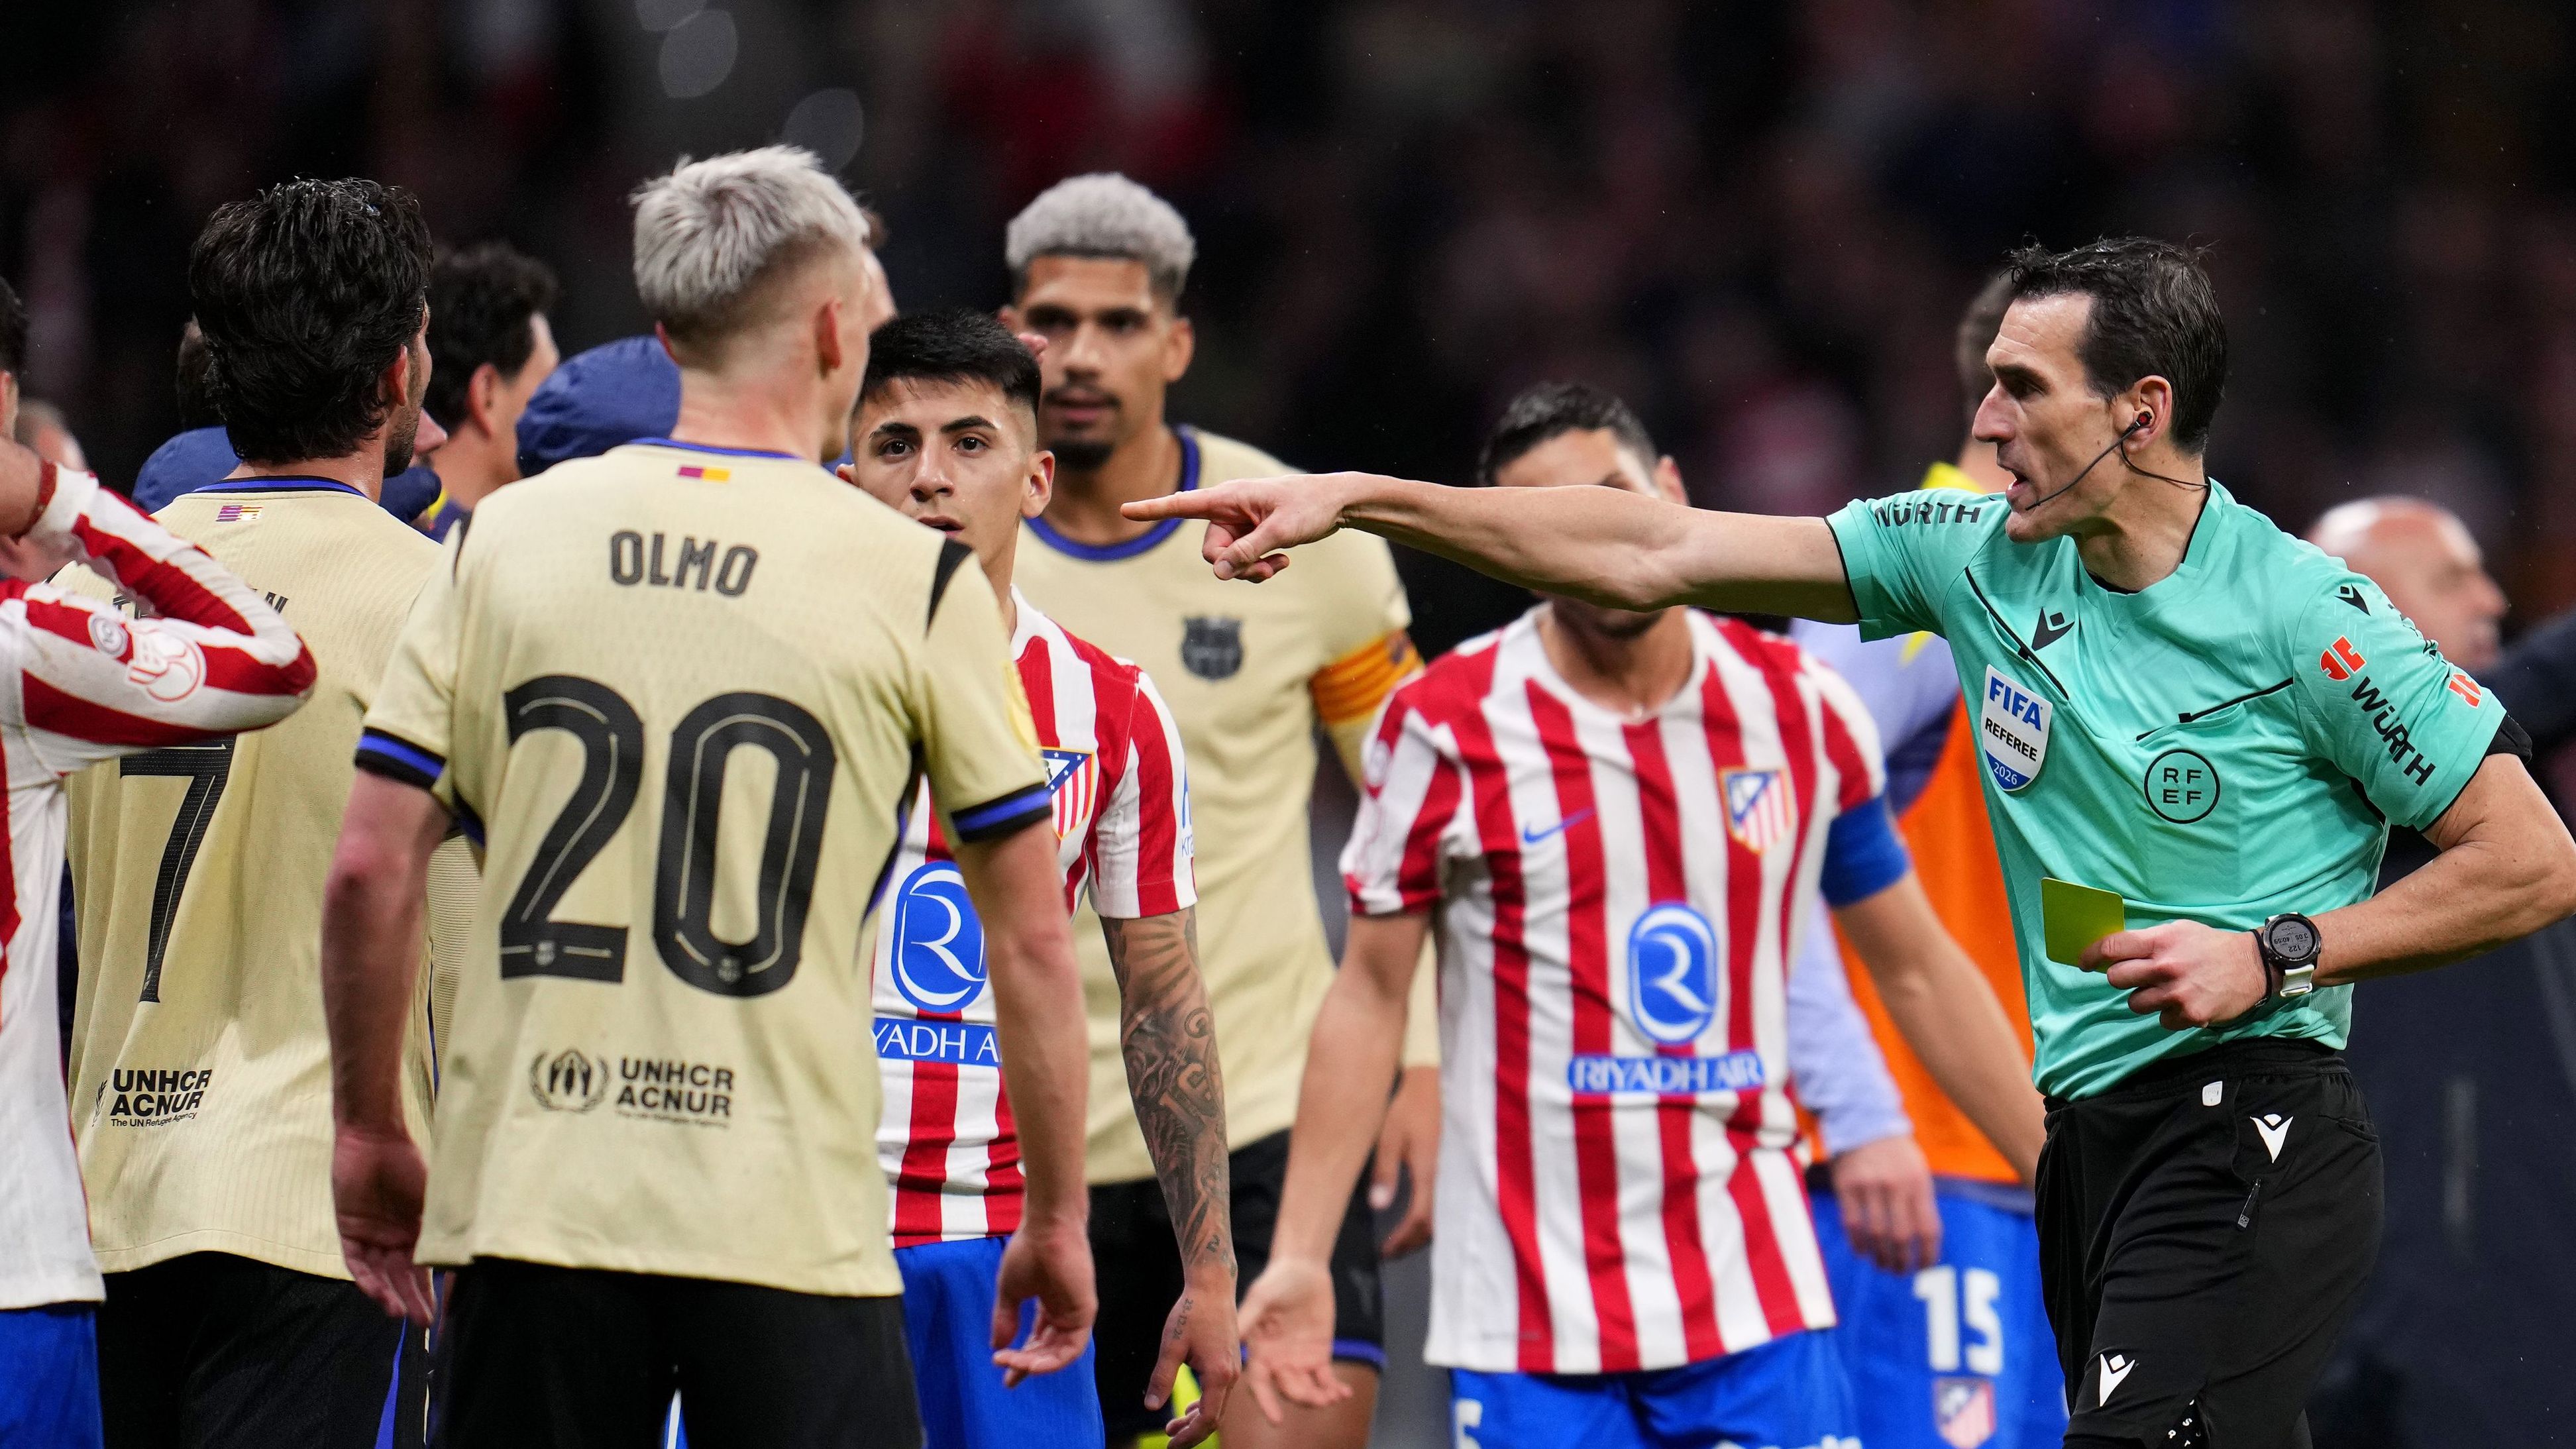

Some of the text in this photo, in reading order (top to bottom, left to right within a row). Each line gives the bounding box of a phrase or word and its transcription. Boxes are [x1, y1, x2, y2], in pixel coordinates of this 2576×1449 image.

[610, 531, 758, 597] OLMO
[1989, 675, 2042, 732] FIFA
[1985, 717, 2038, 762] REFEREE
[2351, 676, 2436, 787] WÜRTH
[1993, 765, 2018, 786] 2026
[499, 674, 837, 1000] 20
[120, 734, 240, 1003] 7
[113, 1068, 213, 1093] UNHCR
[621, 1057, 734, 1090] UNHCR
[1574, 1059, 1709, 1092] RIYADH
[110, 1091, 204, 1117] ACNUR
[130, 1118, 144, 1127] UN
[145, 1116, 172, 1127] Refugee
[172, 1111, 197, 1123] Agency
[617, 1084, 730, 1116] ACNUR
[1911, 1264, 2004, 1375] 15
